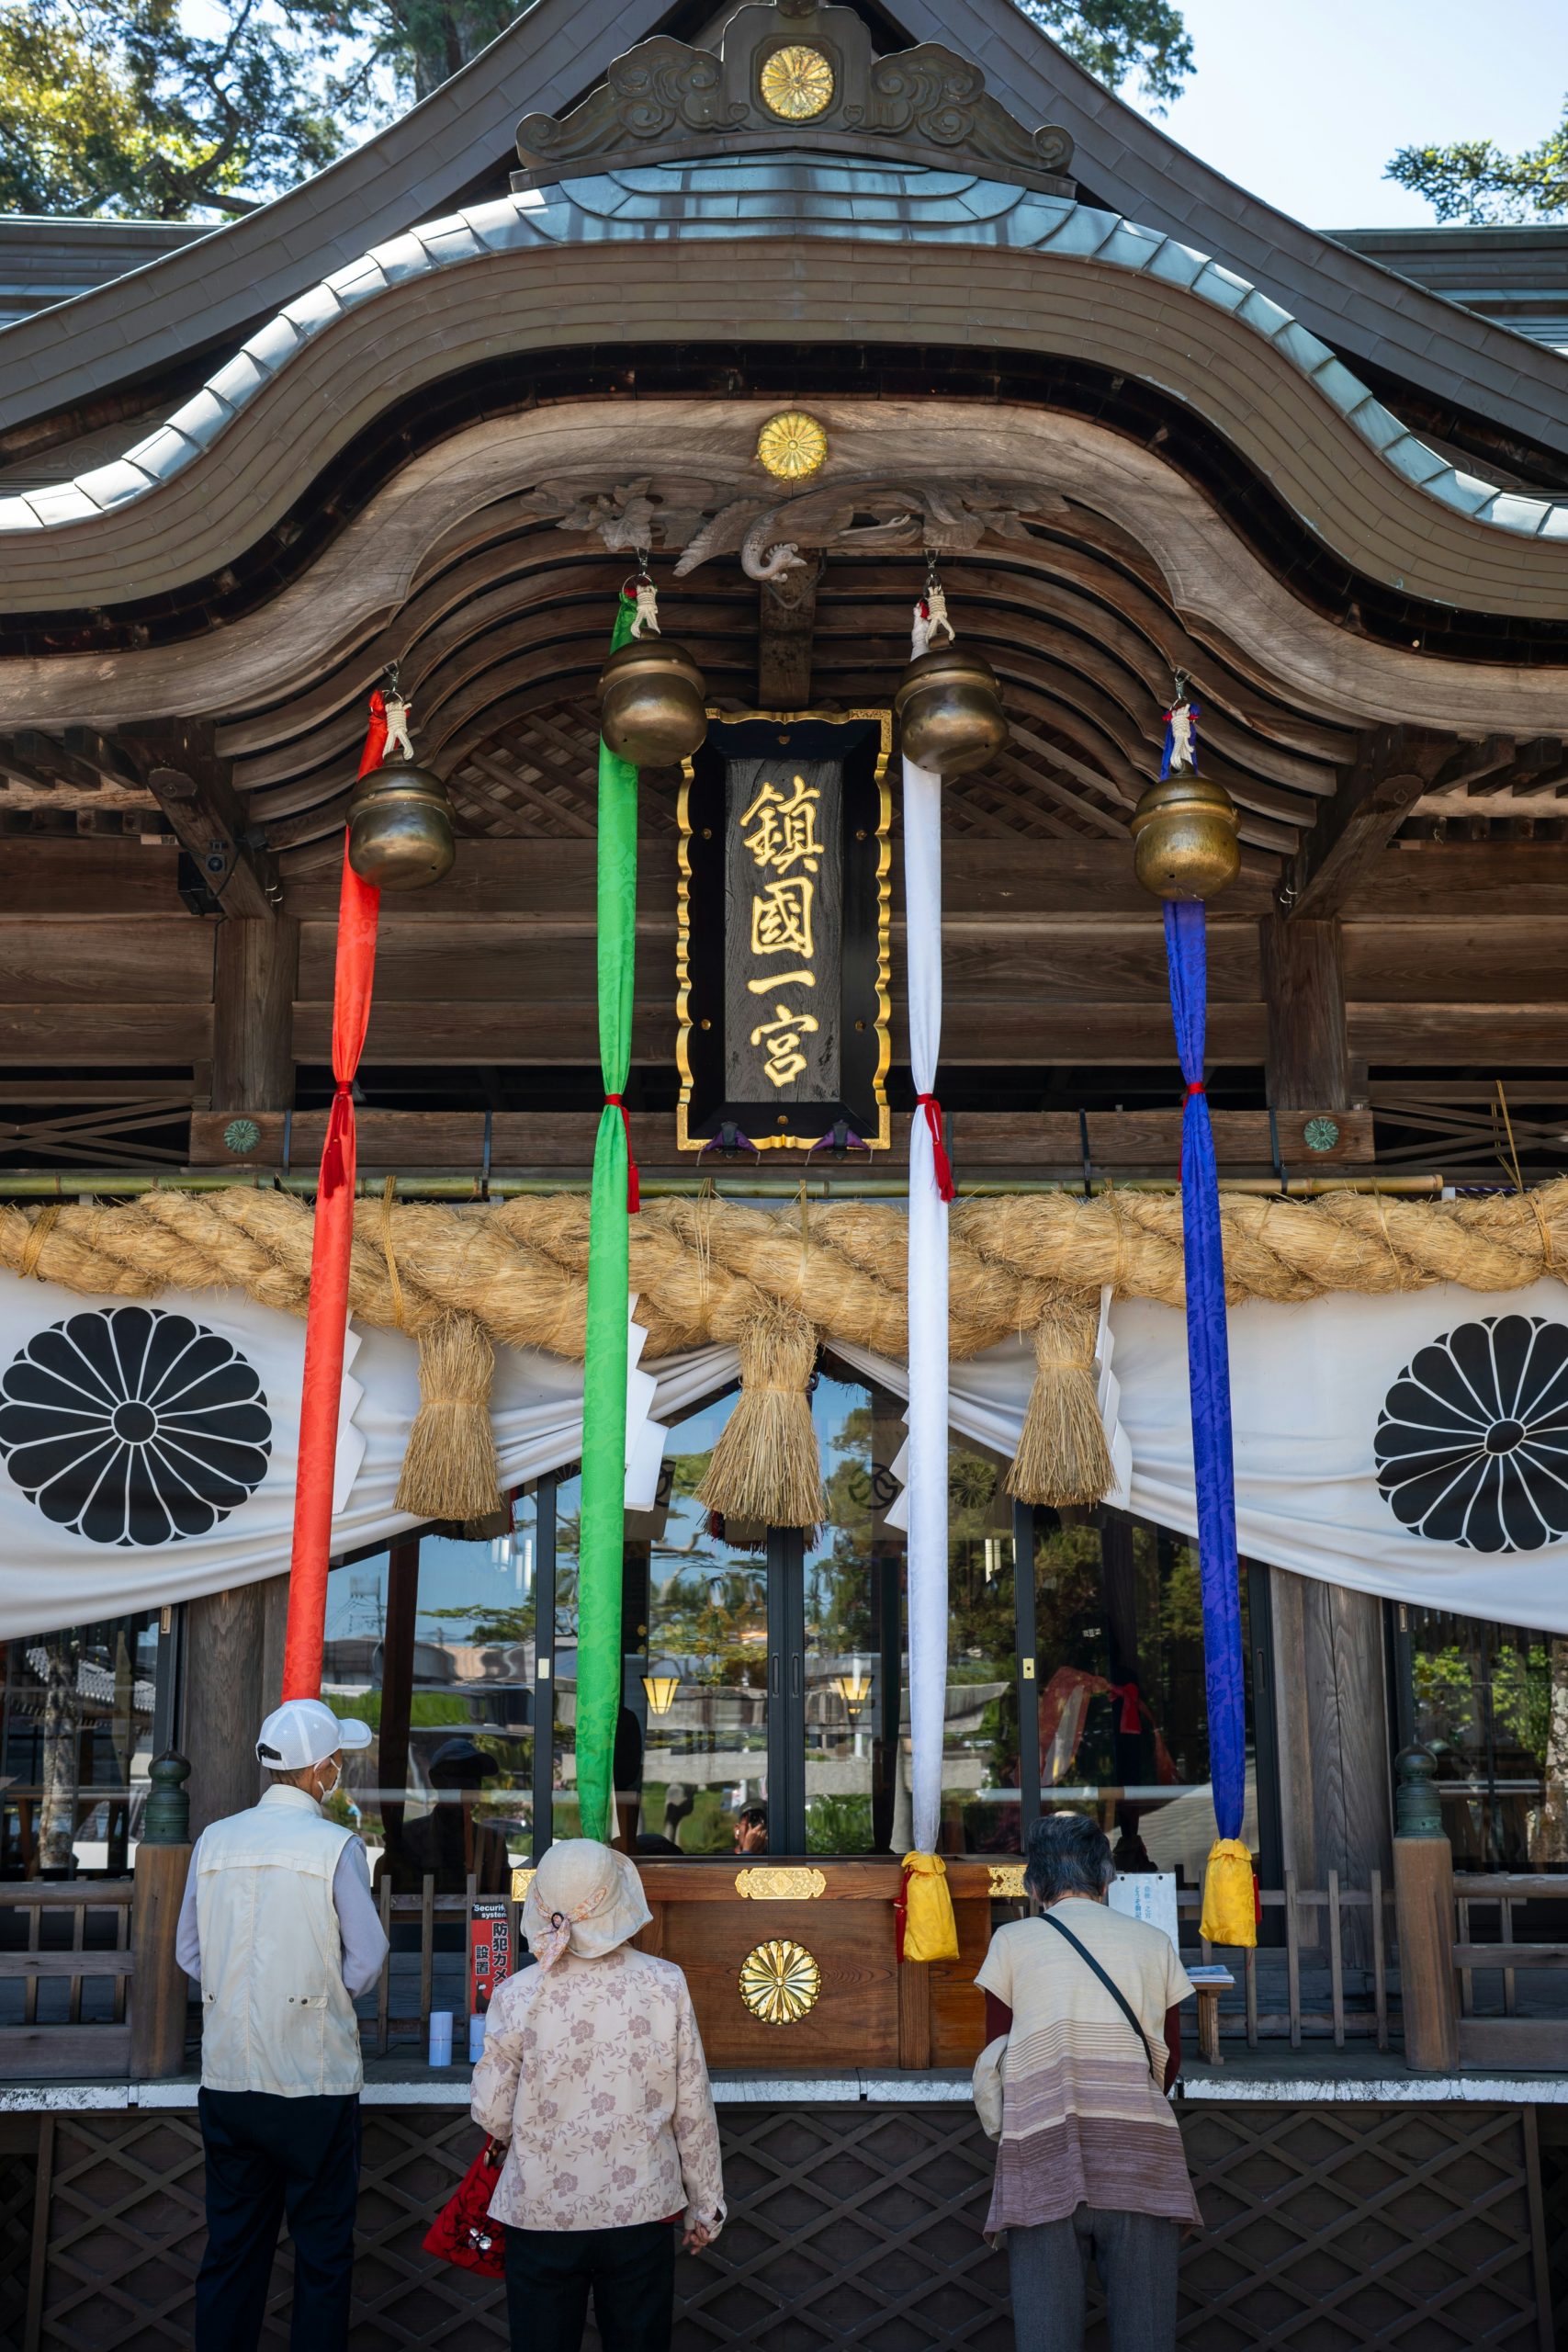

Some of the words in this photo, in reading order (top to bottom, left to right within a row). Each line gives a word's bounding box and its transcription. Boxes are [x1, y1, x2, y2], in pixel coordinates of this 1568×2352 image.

[476, 1945, 490, 1975] 設置
[491, 1921, 509, 1988] 防犯カメ
